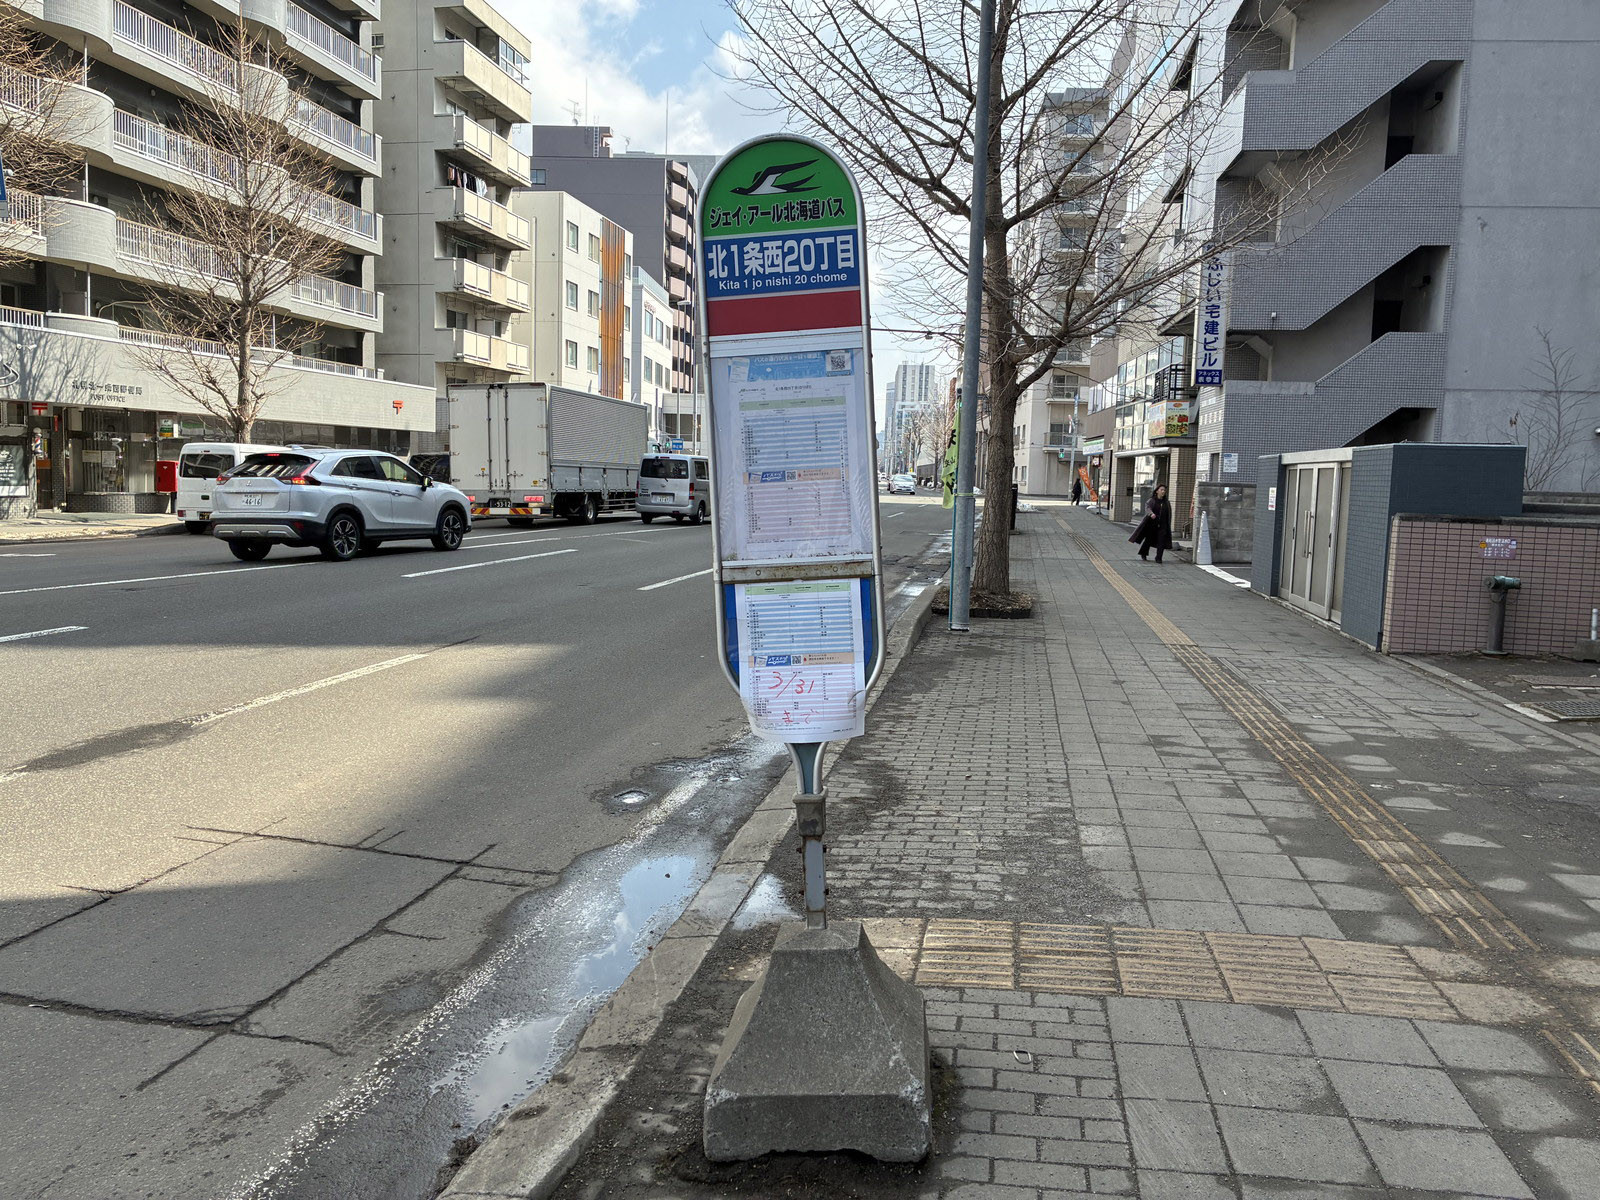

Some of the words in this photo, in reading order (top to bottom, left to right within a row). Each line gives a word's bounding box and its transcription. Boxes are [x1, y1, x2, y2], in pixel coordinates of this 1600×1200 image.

[709, 197, 846, 229] ジェイ・アール北海道バス
[707, 234, 855, 279] 北1条西20丁目
[719, 279, 740, 290] Kita
[743, 278, 748, 289] 1
[752, 277, 763, 290] jo
[765, 275, 792, 287] nishi
[794, 274, 808, 285] 20
[810, 272, 848, 284] chome
[768, 671, 815, 698] 3/31
[782, 709, 820, 725] まで
